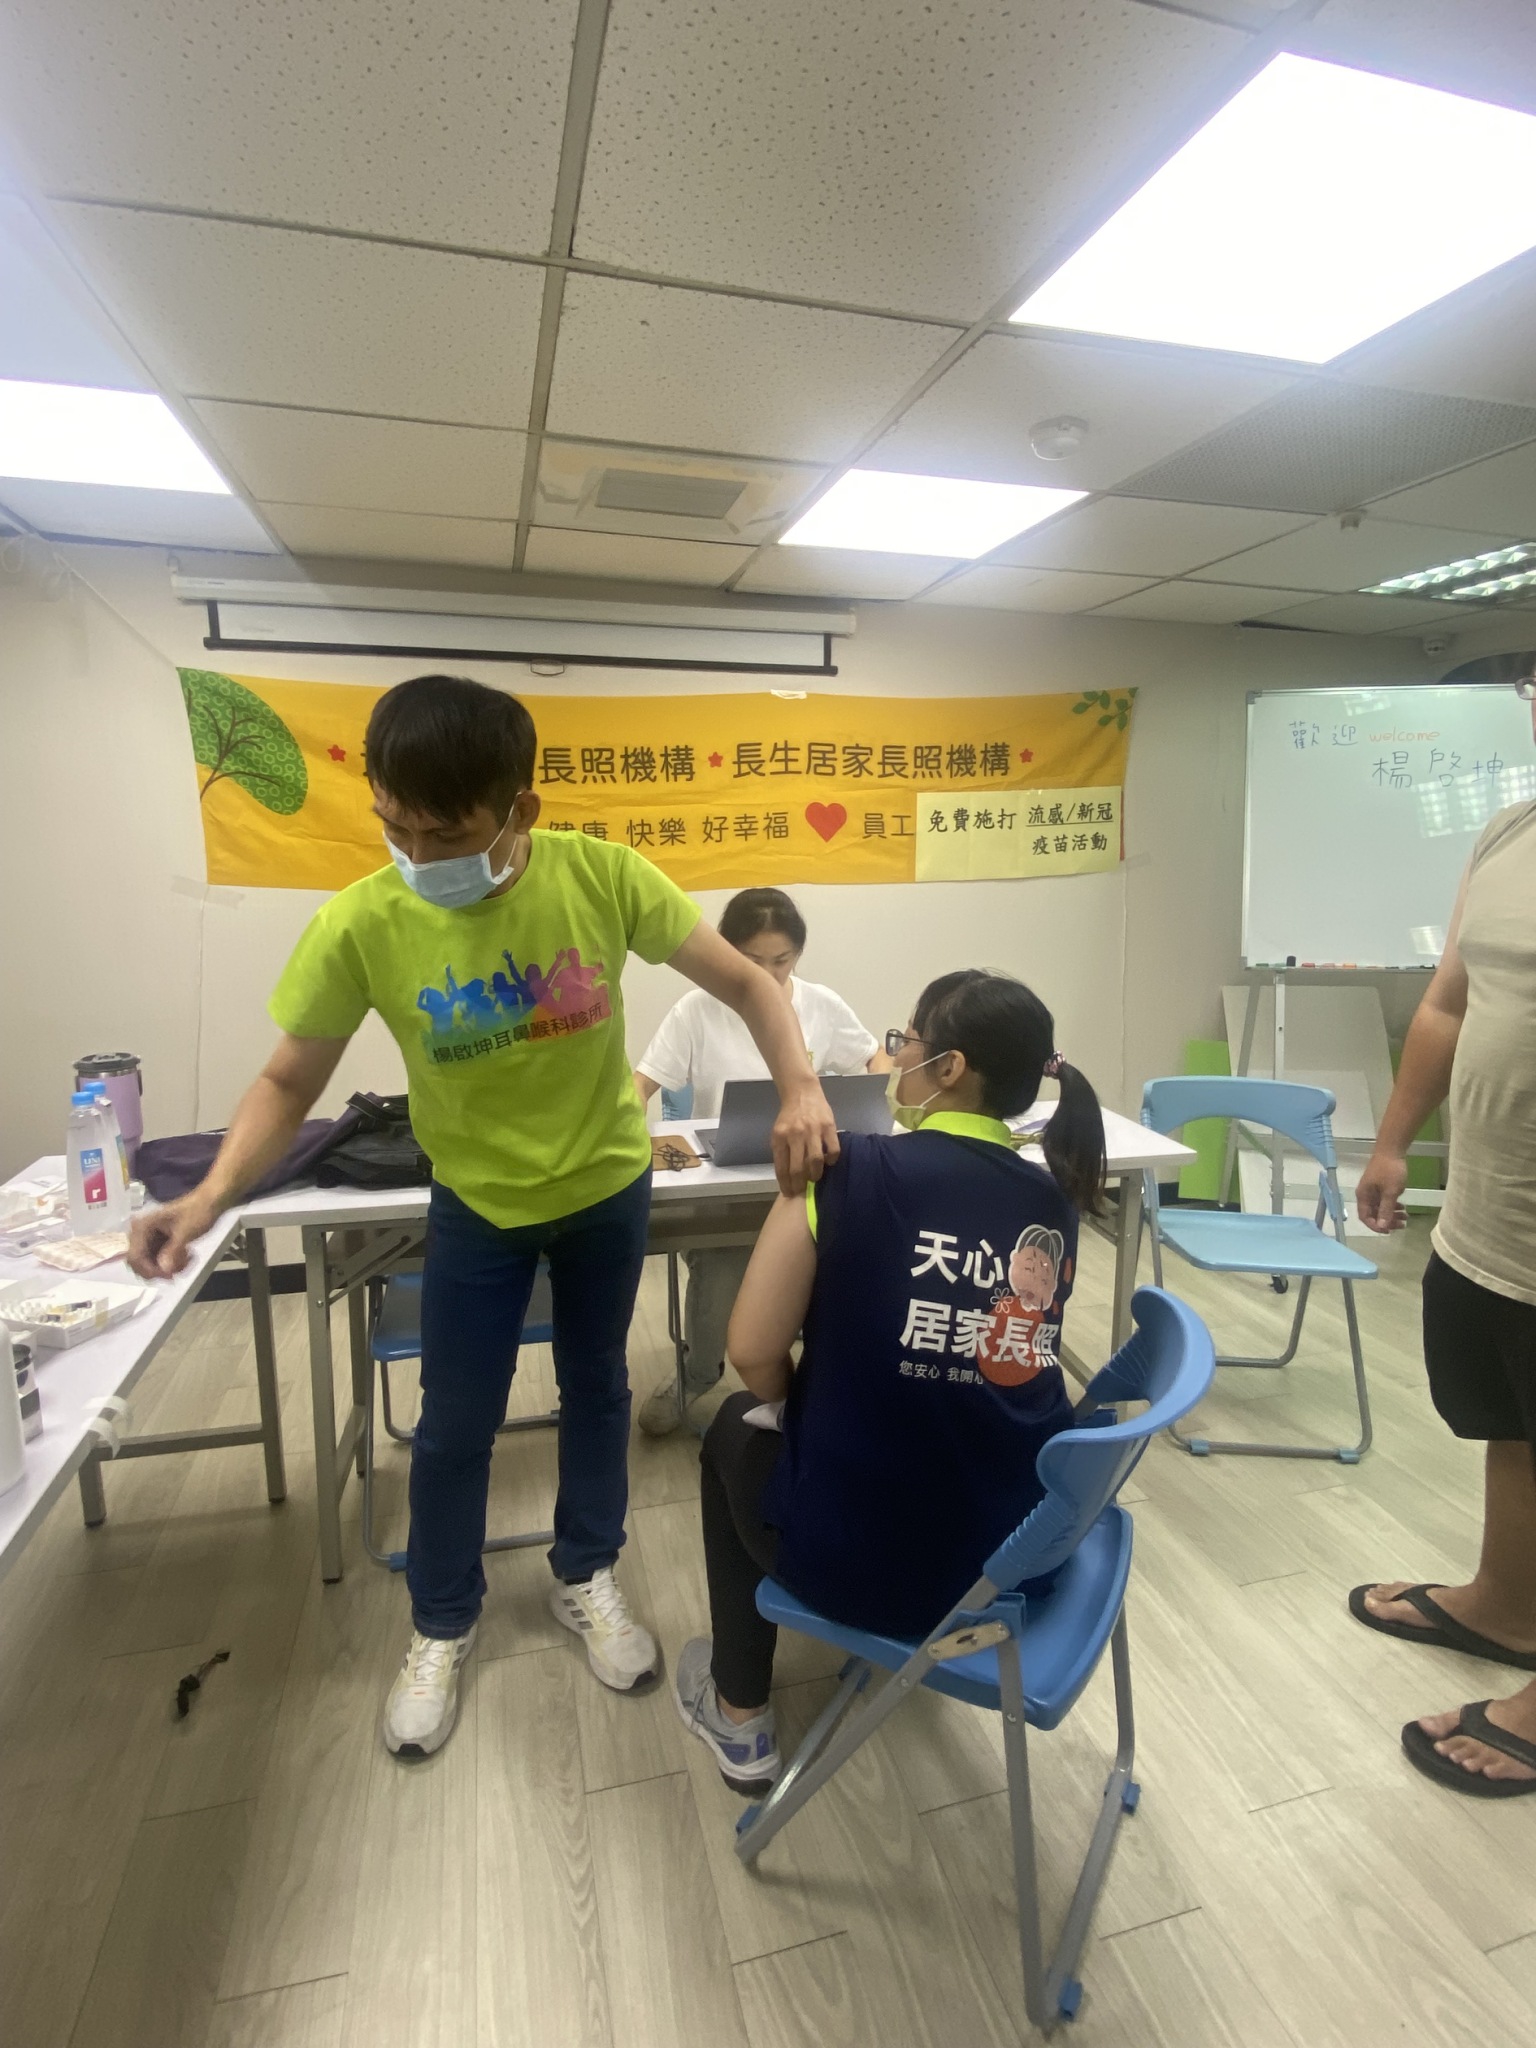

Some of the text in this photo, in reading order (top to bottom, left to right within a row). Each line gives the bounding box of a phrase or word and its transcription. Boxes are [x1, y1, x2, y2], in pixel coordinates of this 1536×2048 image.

[1369, 726, 1441, 743] welcome
[732, 740, 1011, 780] 長生居家長照機構
[626, 817, 687, 848] 快樂
[702, 811, 789, 844] 好幸福
[862, 812, 915, 840] 員工
[927, 802, 1113, 833] 免費施打 流感/新冠
[1032, 831, 1107, 856] 疫苗活動
[910, 1230, 1004, 1289] 天心
[899, 1298, 1060, 1369] 居家長照
[899, 1360, 940, 1378] 您安心
